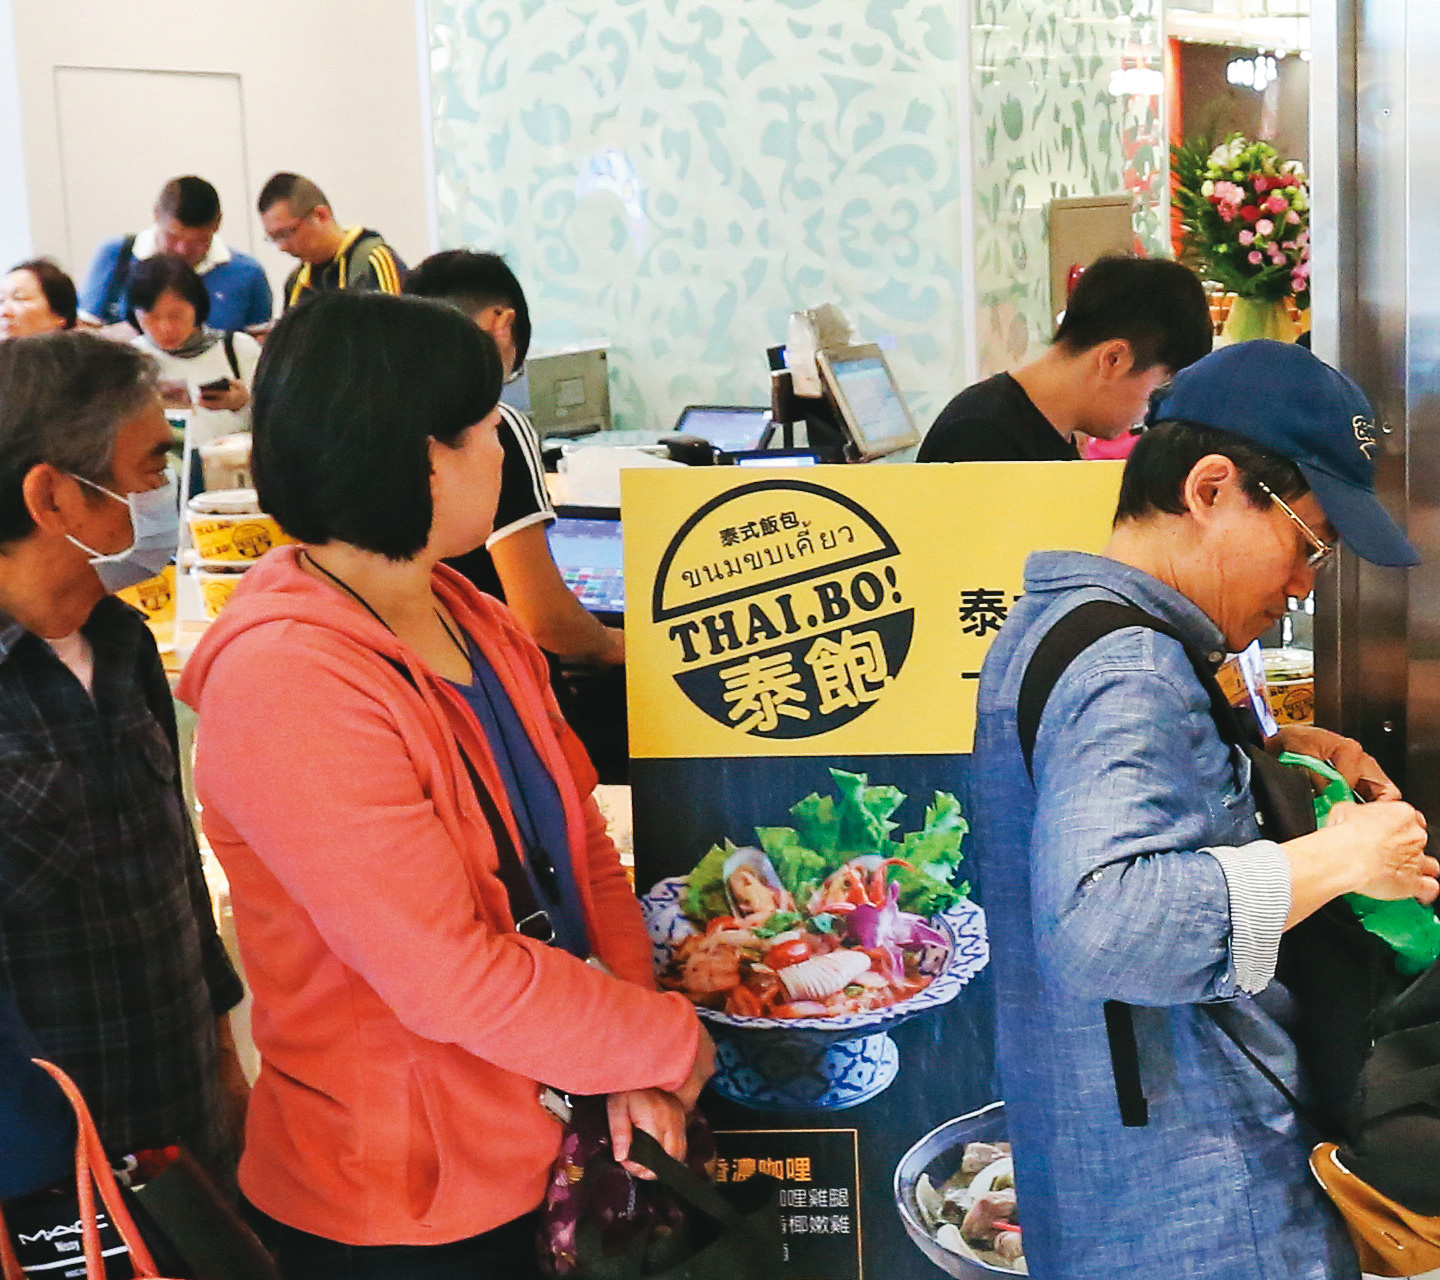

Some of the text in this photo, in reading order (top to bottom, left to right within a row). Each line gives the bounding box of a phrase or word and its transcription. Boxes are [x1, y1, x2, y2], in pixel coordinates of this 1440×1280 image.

[682, 520, 855, 588] ขนมขบเคี้ยว
[720, 511, 800, 547] 泰式飯包
[669, 565, 902, 663] THAI.BO!
[719, 629, 896, 733] 泰飽
[780, 1215, 851, 1234] 椰嫩雞
